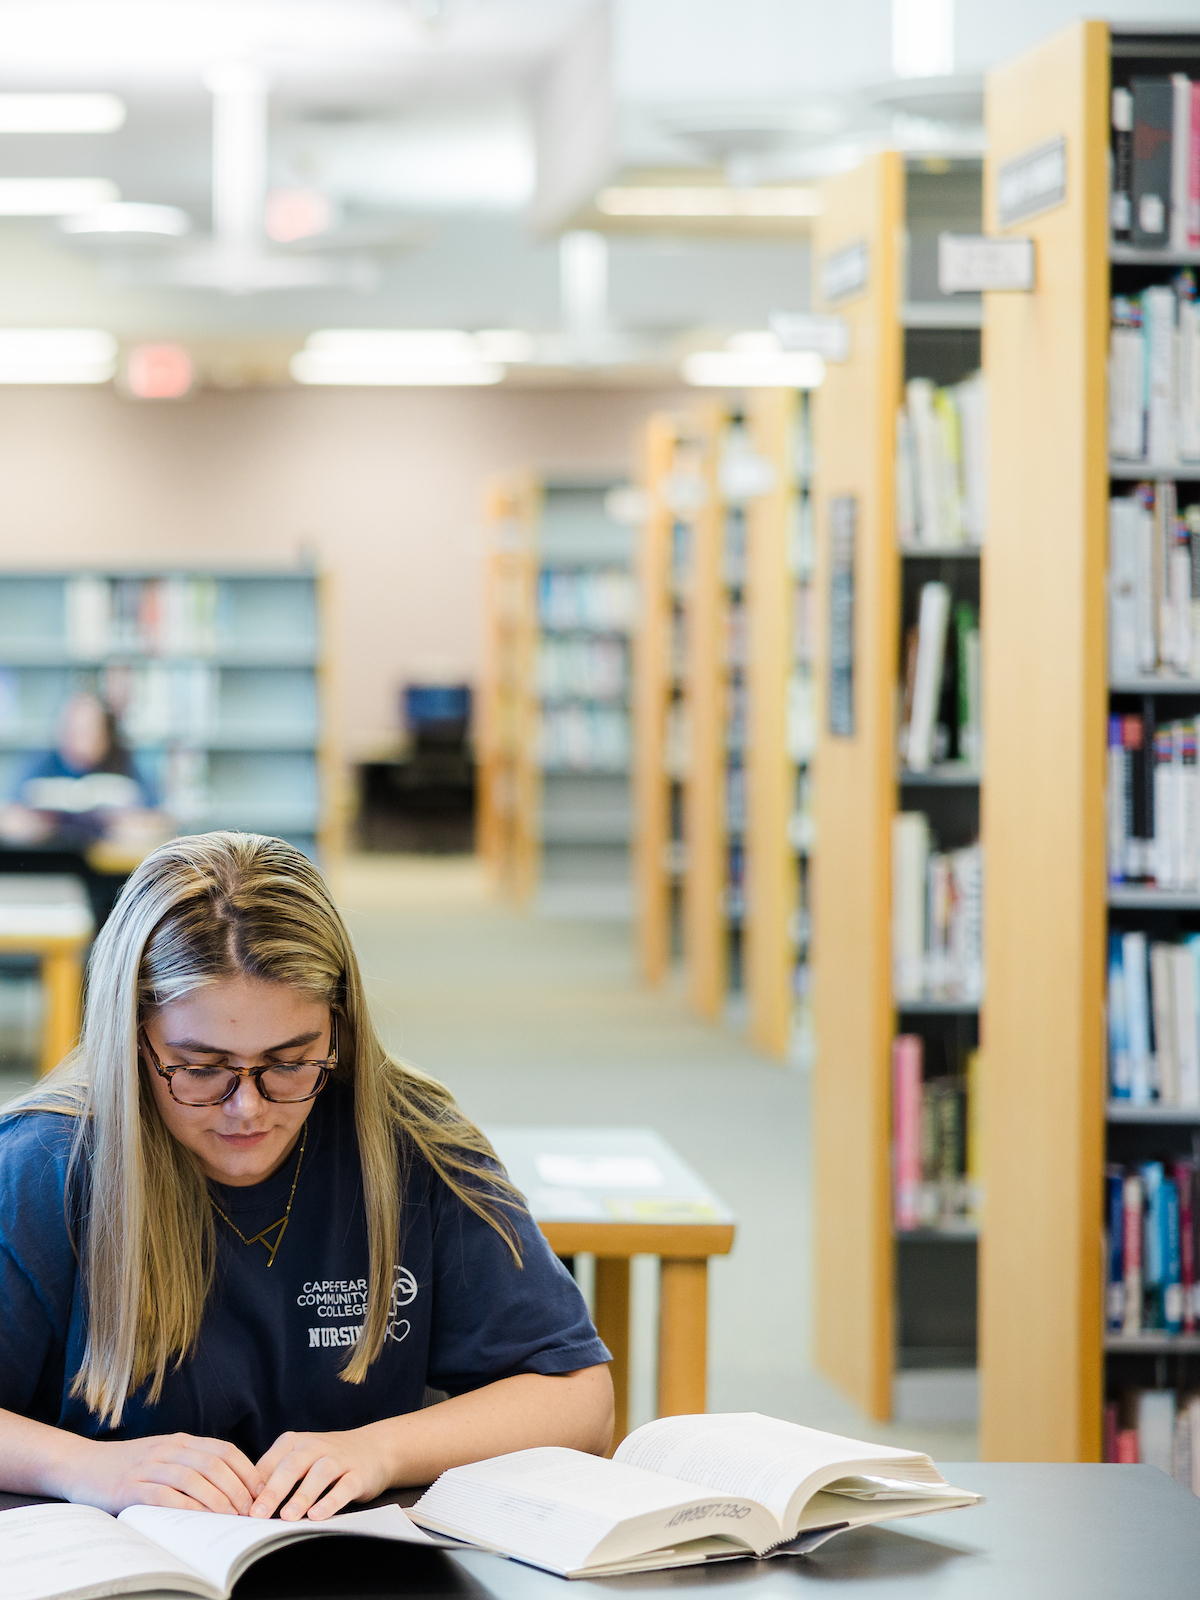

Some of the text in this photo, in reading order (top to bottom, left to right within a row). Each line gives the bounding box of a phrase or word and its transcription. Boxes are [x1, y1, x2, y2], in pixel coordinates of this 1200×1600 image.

[297, 1290, 368, 1307] COMMUNITY
[317, 1303, 368, 1318] COLLEGE
[663, 1503, 722, 1530] LIBRARY
